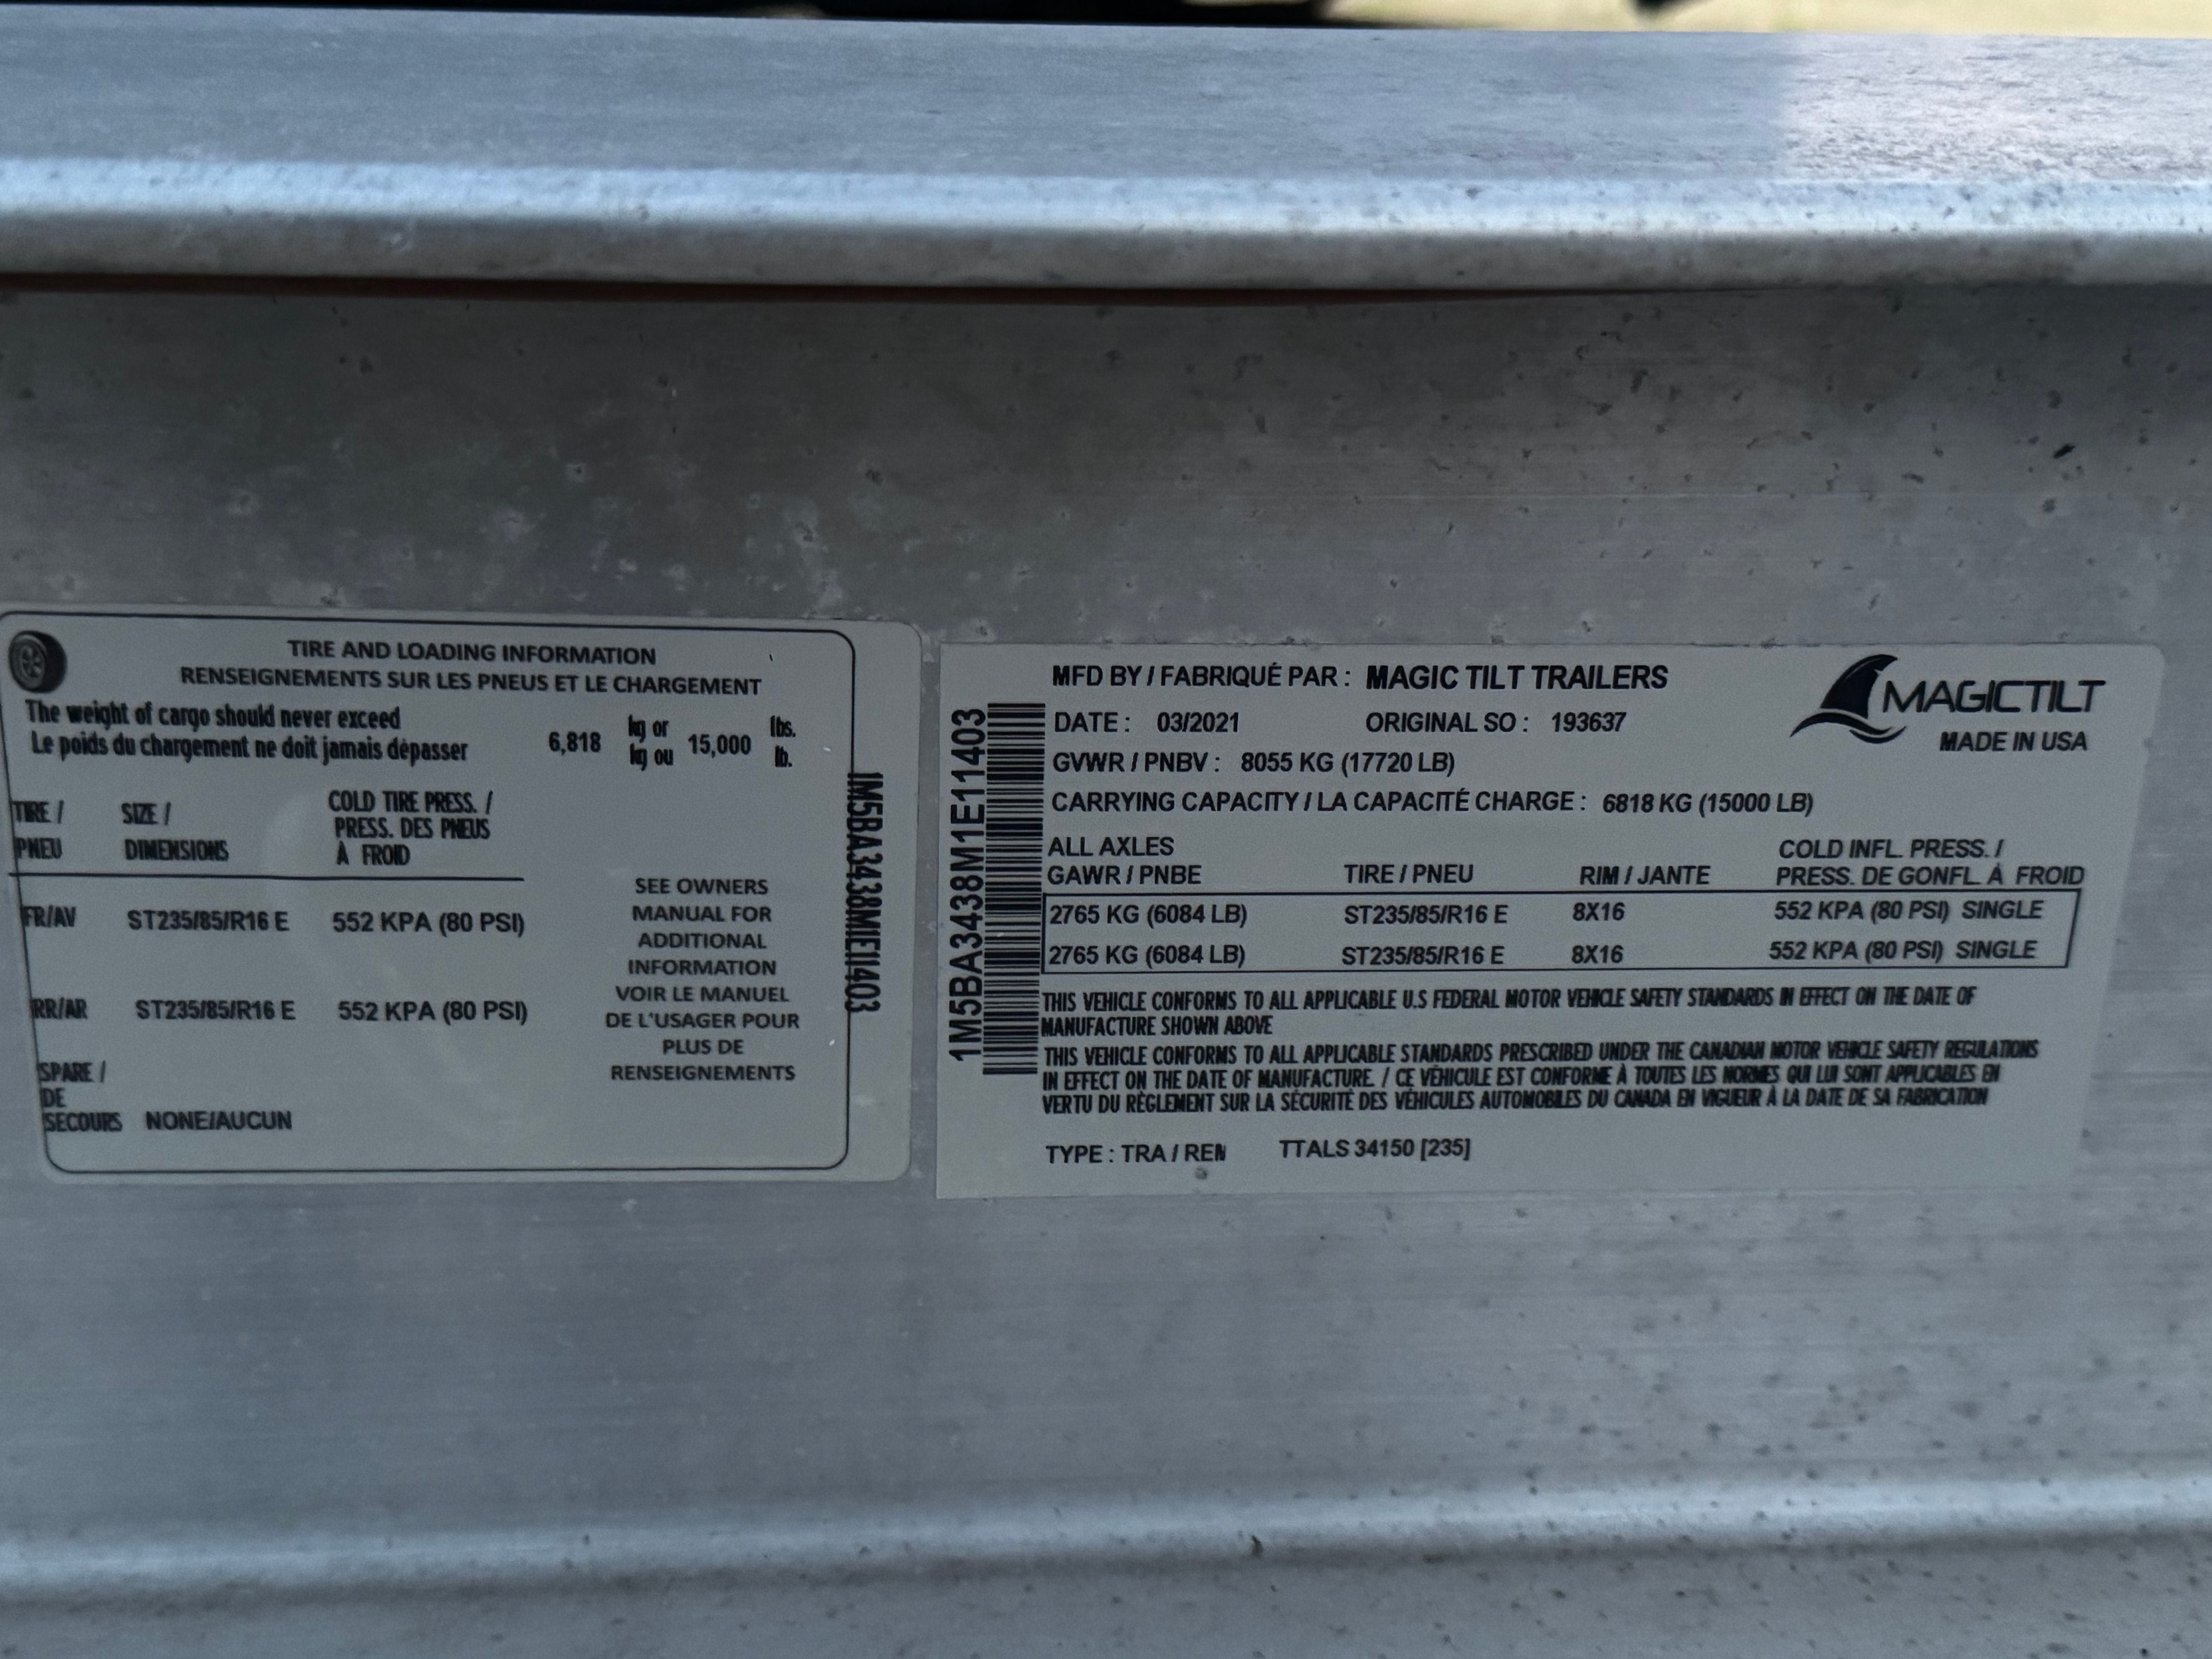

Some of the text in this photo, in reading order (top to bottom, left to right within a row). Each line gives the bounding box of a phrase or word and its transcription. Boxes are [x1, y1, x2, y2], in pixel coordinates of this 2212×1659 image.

[287, 640, 656, 665] TIRE AND LOADING INFORMATION
[180, 666, 762, 695] RENSEIGNEMENTS SUR LES PNEUS ET LE CHARGEMENT
[1053, 662, 1669, 690] MFD BY FABRIQUÉ PAR MAGIC TILT TRAILERS
[25, 699, 401, 732] The weight of cargo should never exceed
[1054, 711, 1238, 732] DATE 03/2021
[1366, 711, 1627, 733] ORIGINAL SO 193637
[31, 730, 54, 754] Le
[58, 733, 109, 761] poids
[112, 732, 136, 756] du
[139, 733, 250, 763] chargement
[254, 740, 277, 758] ne
[281, 735, 318, 759] doit
[322, 738, 383, 766] jamais
[548, 731, 601, 756] 6,818
[688, 734, 751, 758] 15,000
[1939, 731, 2088, 752] MADE IN USA
[1053, 752, 1455, 778] GVWR PNBV 8055 KG (17720 LB)
[328, 790, 477, 814] COLD TIRE PRESS.
[1052, 787, 1814, 818] CARRYING CAPACITY LA CAPACITÉ CHARGE 6818 KG (15000 LB)
[121, 802, 158, 825] SIZE
[334, 816, 491, 840] PRESS. DES PNEUS
[124, 838, 229, 862] DIMENSIONS
[362, 844, 410, 866] FROID
[1048, 836, 1174, 857] ALL AXLES
[1779, 839, 1844, 859] COLD
[1910, 838, 1989, 858] PRESS.
[948, 708, 986, 1061] 1M5BA3438M1E11403
[1047, 864, 1202, 885] GAWR PNBE
[1344, 864, 1474, 884] TIRE PNEU
[1580, 865, 1711, 885] RIM JANTE
[1776, 866, 1855, 886] PRESS.
[1862, 866, 1894, 886] DE
[2015, 865, 2085, 886] FROID
[635, 878, 769, 895] SEE OWNERS
[127, 909, 289, 932] ST235/85/R16 E
[632, 905, 771, 922] MANUAL FOR
[1050, 903, 1247, 929] 2765 KG (6084 LB)
[1344, 904, 1509, 924] ST235/85/R16 E
[1572, 902, 1625, 921] 8X16
[1774, 900, 2045, 925] 552 KPA (80 PSI) SINGLE
[332, 911, 525, 938] 552 KPA (80 PSI)
[638, 933, 767, 949] ADDITIONAL
[1769, 940, 2038, 964] 552 KPA (80 PSI) SINGLE
[1049, 944, 1245, 969] 2765 KG (6084 LB)
[1342, 945, 1505, 966] ST235/85/R16 E
[1571, 945, 1624, 964] 8X16
[628, 959, 776, 976] INFORMATION
[615, 986, 789, 1002] VOIR LE MANUEL
[1042, 992, 1077, 1012] THIS
[1083, 991, 1147, 1012] VEHICLE
[1151, 991, 1237, 1011] CONFORMS
[1244, 990, 1264, 1010] TO
[1269, 990, 1298, 1010] ALL
[1303, 989, 1397, 1010] APPLICABLE
[1432, 989, 1500, 1009] FEDERAL
[605, 1012, 632, 1028] DE
[742, 1013, 799, 1029] POUR
[1041, 1015, 1273, 1037] MANUFACTURE SHOWN ABOVE
[663, 1039, 743, 1055] PLUS DE
[611, 1065, 795, 1081] RENSEIGNEMENTS
[145, 1110, 292, 1130] NONE/AUCUN
[1046, 1144, 1103, 1164] TYPE
[1121, 1144, 1167, 1163] TRA
[1279, 1138, 1471, 1161] TTALS 34150 [235]
